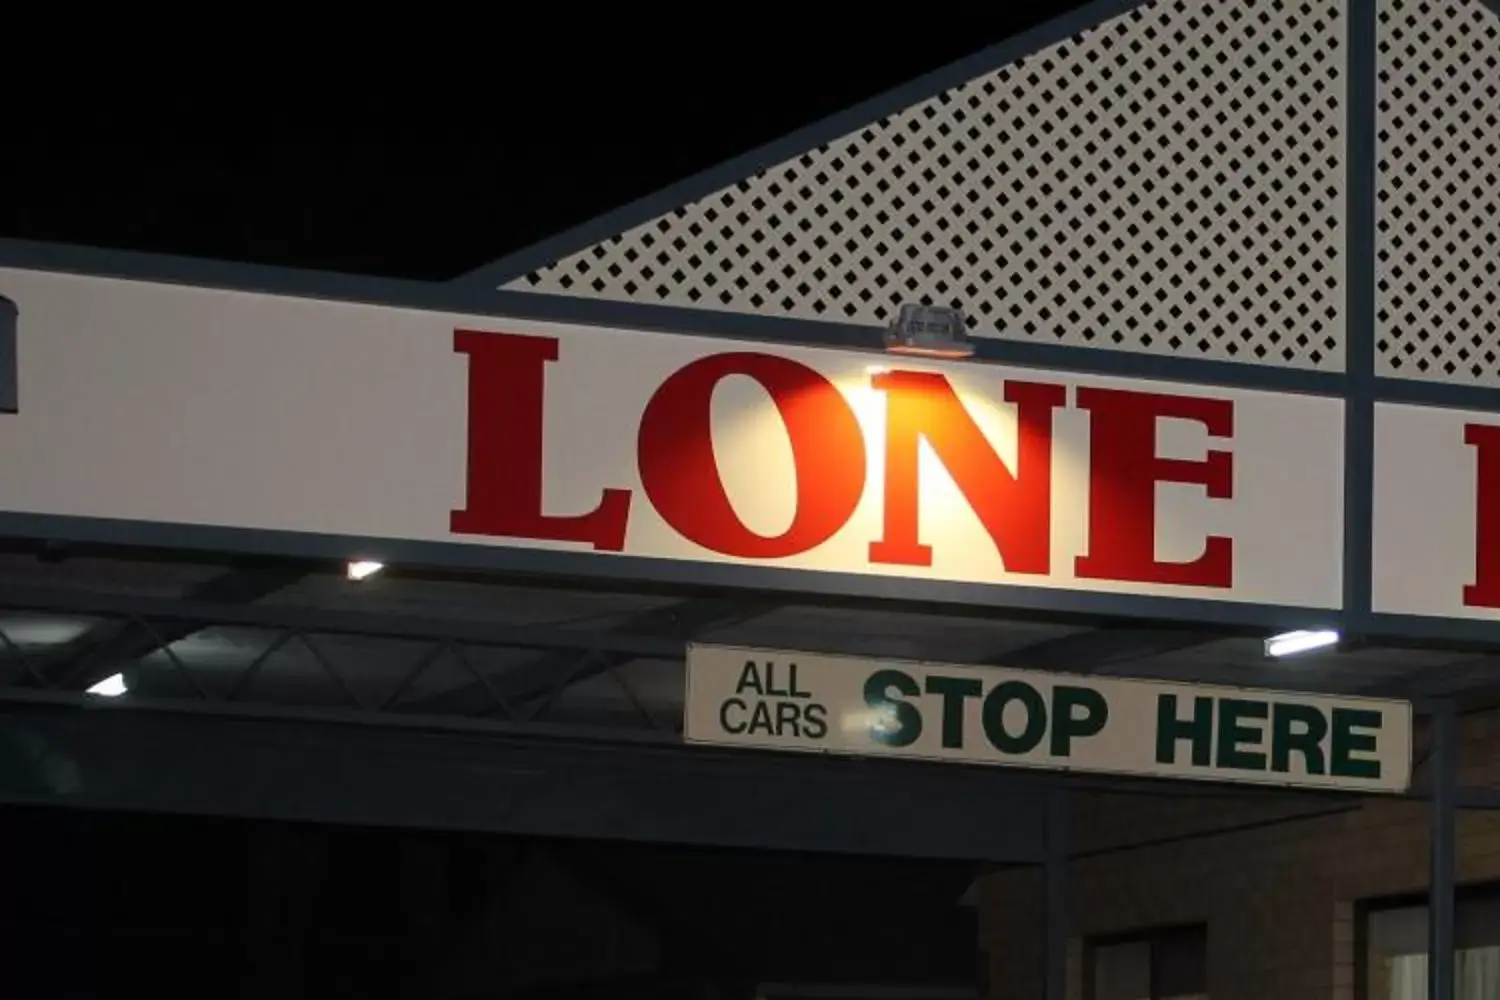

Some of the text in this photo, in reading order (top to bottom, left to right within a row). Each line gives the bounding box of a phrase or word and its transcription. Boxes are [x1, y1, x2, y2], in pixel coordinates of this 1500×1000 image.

[449, 327, 1234, 588] LONE
[735, 660, 812, 698] ALL
[719, 698, 827, 740] CARS
[863, 669, 1383, 779] STOP HERE
